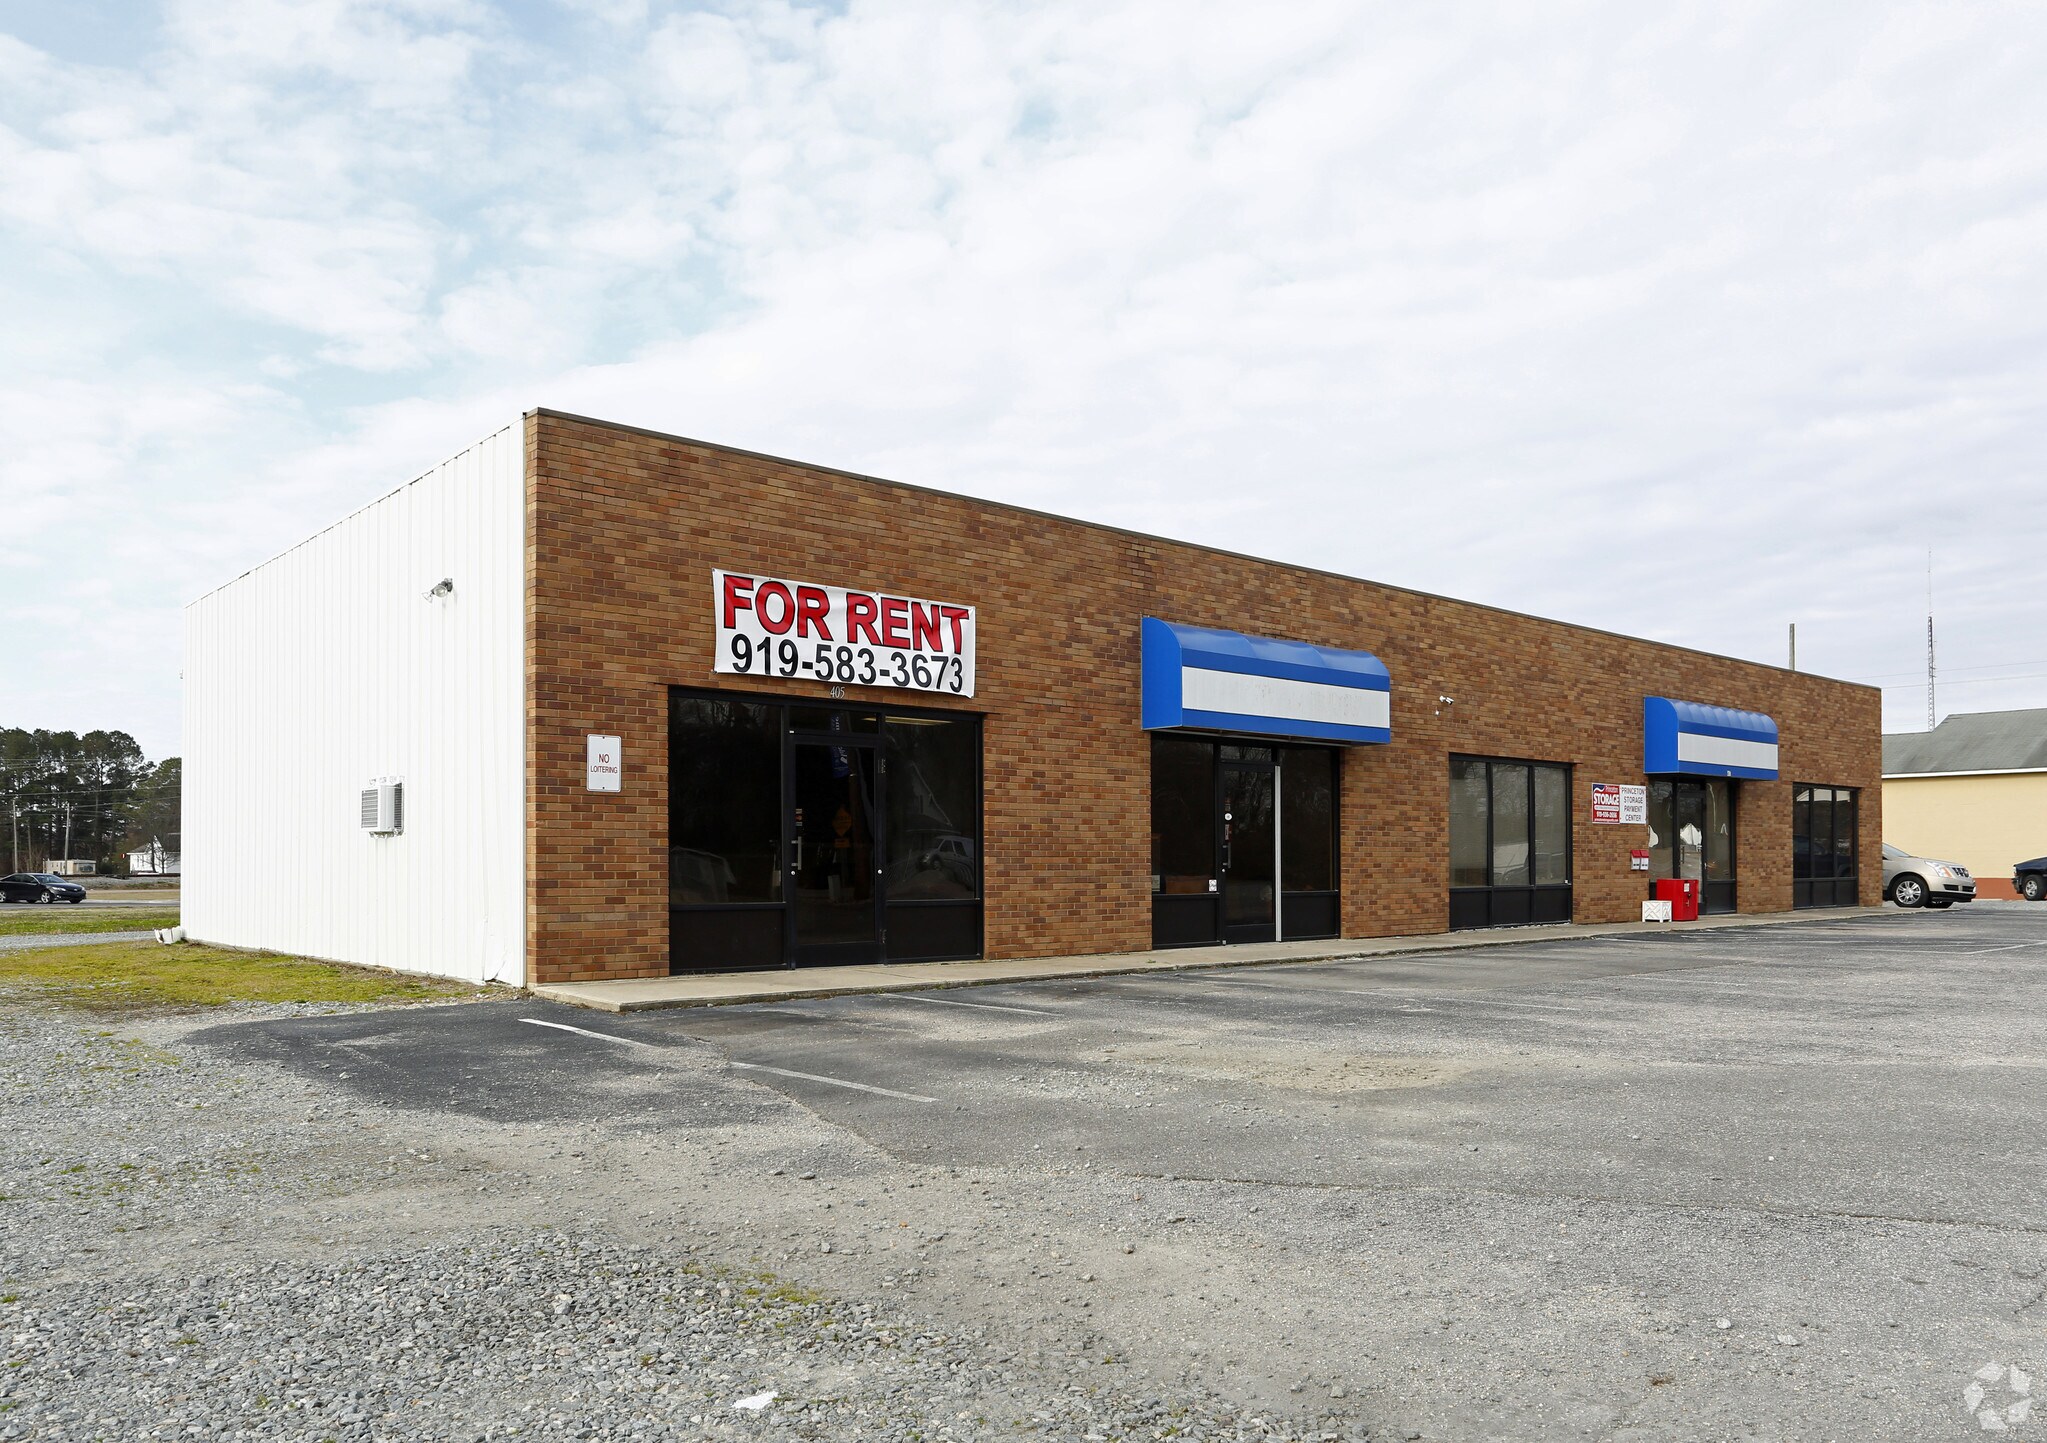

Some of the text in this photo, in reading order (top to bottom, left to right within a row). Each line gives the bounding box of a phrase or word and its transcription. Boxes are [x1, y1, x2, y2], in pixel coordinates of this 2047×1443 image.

[723, 573, 969, 655] FOR RENT
[731, 633, 963, 693] 919-583-3673
[830, 685, 845, 699] 405
[598, 753, 610, 764] NO
[590, 765, 618, 774] LOITERING
[1621, 787, 1645, 795] PRINCETON
[1593, 793, 1620, 805] STORAGE
[1624, 796, 1643, 804] STORAGE
[1624, 805, 1643, 813] PAYMENT
[1625, 814, 1642, 822] CENTER
